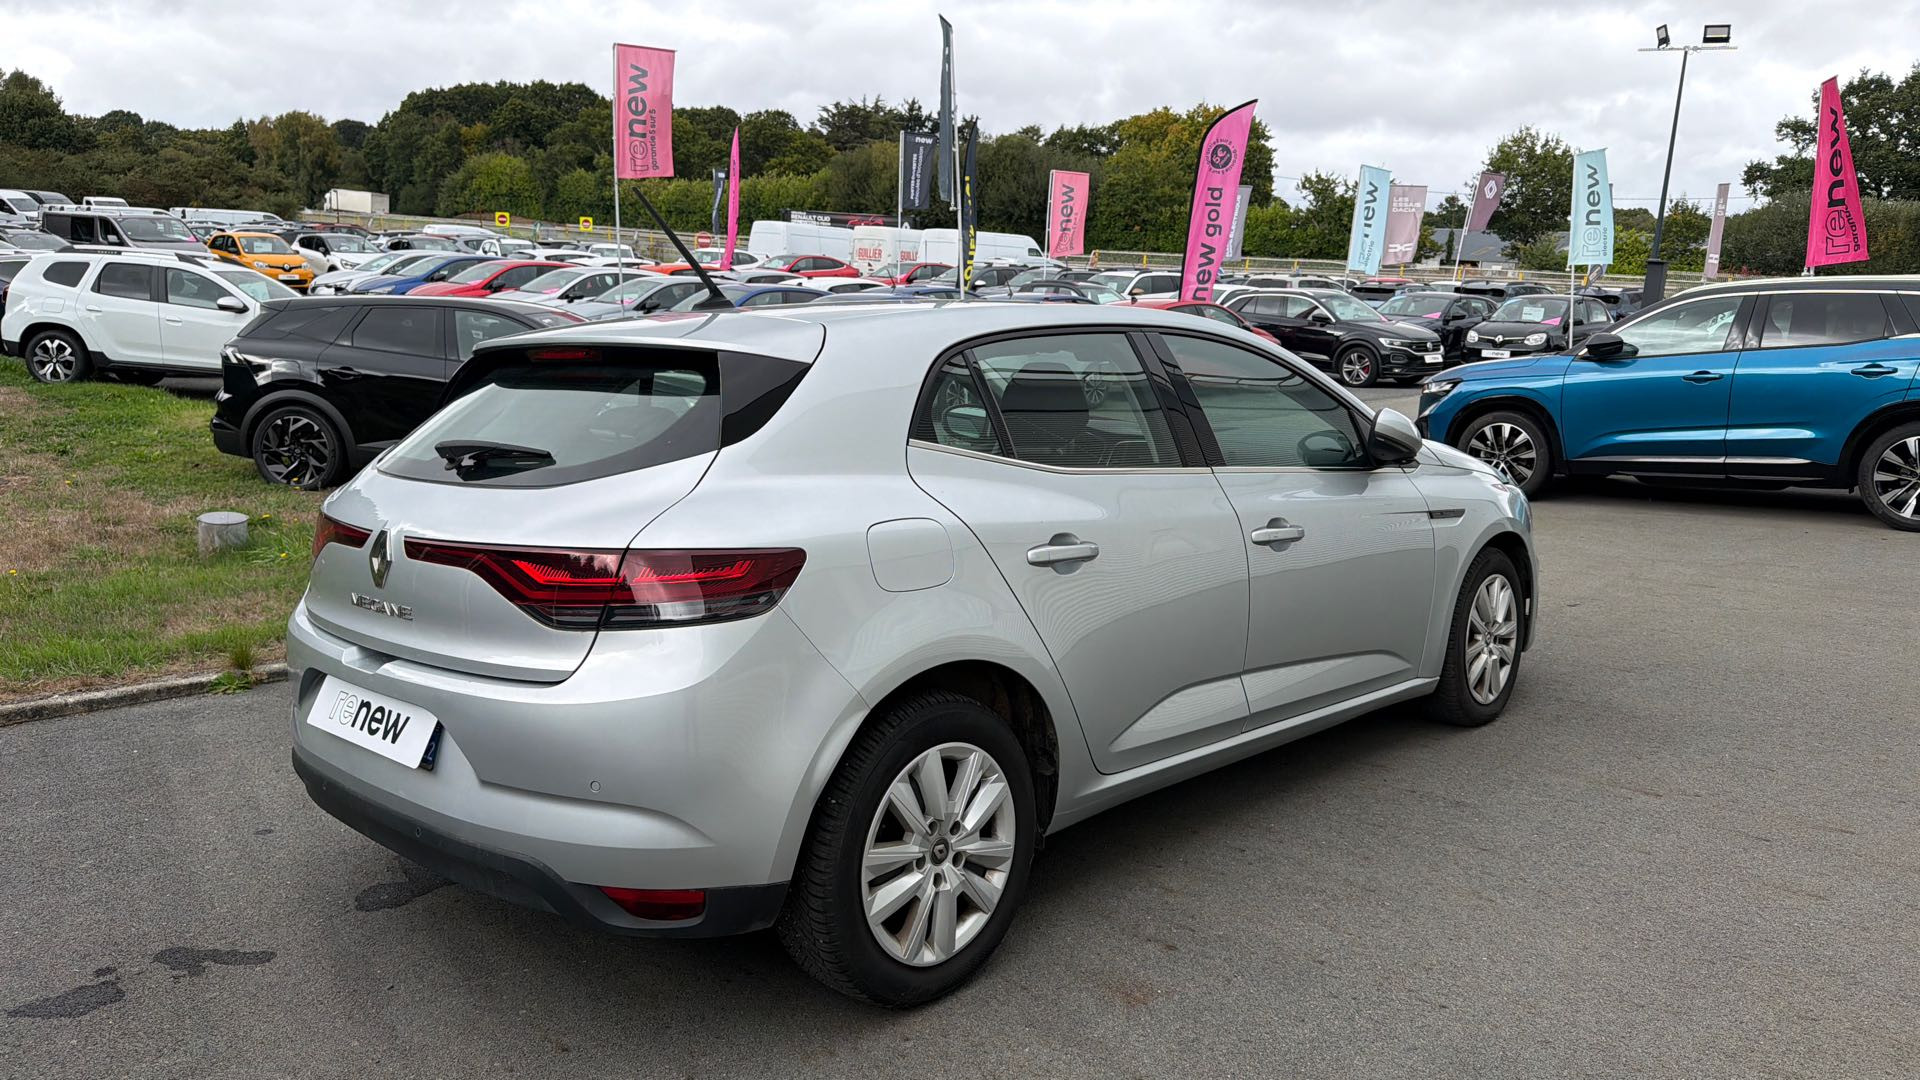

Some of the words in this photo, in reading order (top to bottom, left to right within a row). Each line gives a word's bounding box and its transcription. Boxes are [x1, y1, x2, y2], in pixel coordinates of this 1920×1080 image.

[627, 63, 649, 172] renew
[649, 115, 657, 128] sur
[649, 136, 659, 171] garantie
[1825, 107, 1850, 255] renew
[791, 214, 816, 222] RENAULT
[1205, 187, 1223, 237] gold
[1583, 163, 1601, 257] renew
[329, 690, 411, 745] renew
